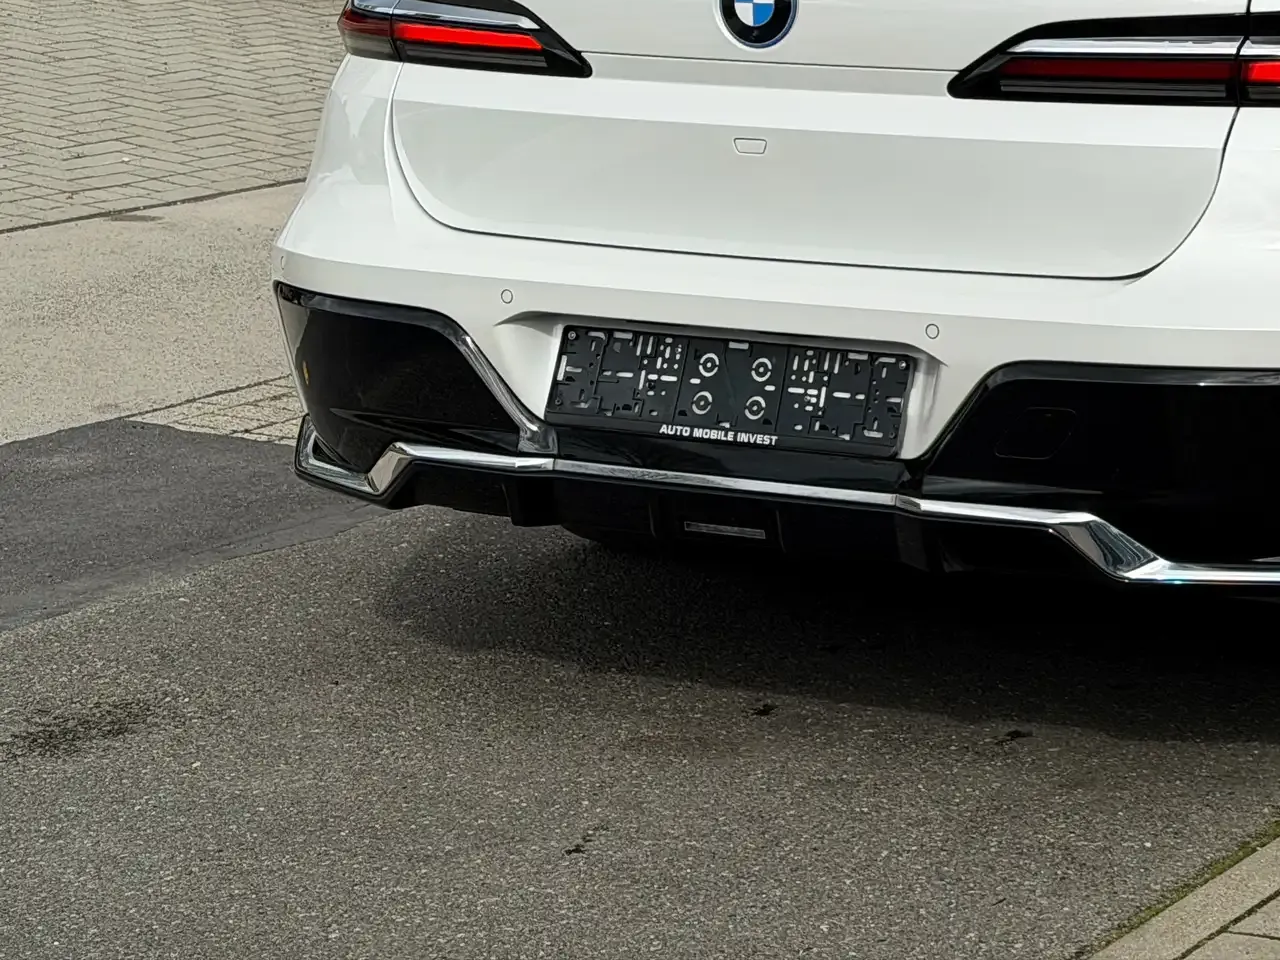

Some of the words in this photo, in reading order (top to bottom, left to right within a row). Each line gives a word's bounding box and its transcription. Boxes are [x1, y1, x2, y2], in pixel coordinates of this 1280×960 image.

[659, 424, 691, 437] AUTO
[692, 427, 735, 442] MOBILE
[736, 432, 779, 446] INVEST
